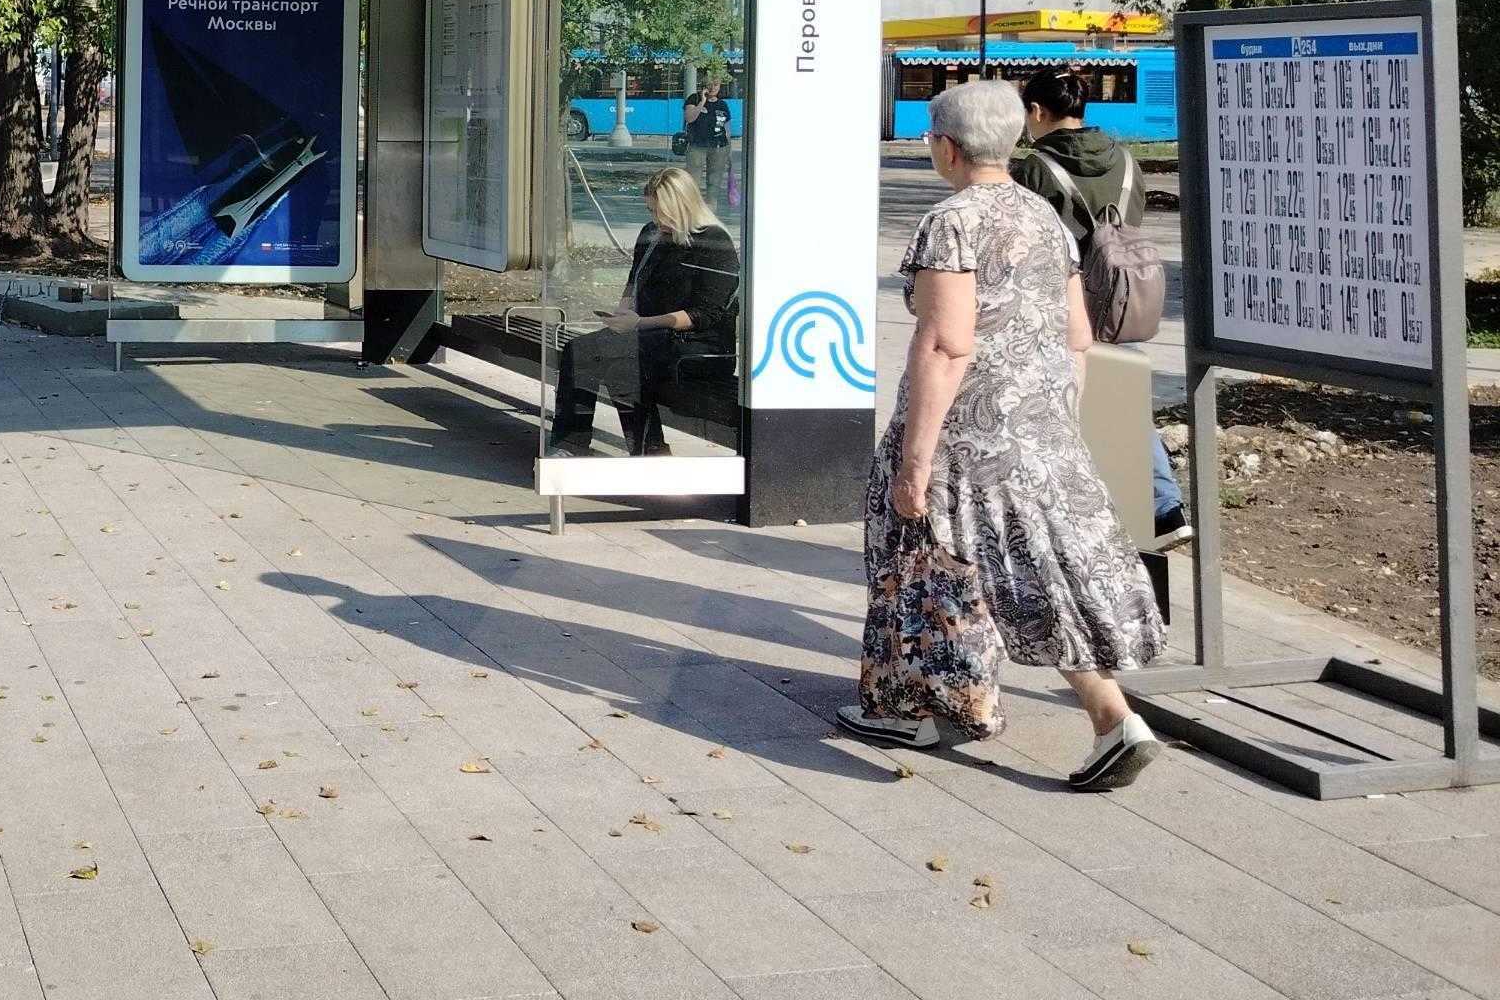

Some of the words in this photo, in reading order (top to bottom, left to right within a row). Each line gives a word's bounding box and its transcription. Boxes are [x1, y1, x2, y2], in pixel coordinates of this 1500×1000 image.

[207, 16, 276, 31] Москвы
[232, 0, 319, 14] транспорт
[1240, 44, 1263, 56] будни
[1301, 39, 1317, 56] 254
[1217, 63, 1222, 108] 5
[1235, 63, 1246, 108] 10
[1259, 62, 1270, 108] 15
[1284, 62, 1295, 108] 20
[1313, 61, 1319, 108] 5
[1334, 60, 1345, 108] 10
[1360, 60, 1372, 109] 15
[1388, 60, 1400, 109] 20
[1219, 116, 1224, 160] 6
[1237, 115, 1246, 161] 11
[1262, 116, 1272, 162] 16
[1286, 116, 1296, 163] 21
[1316, 117, 1321, 164] 6
[1336, 116, 1346, 165] 11
[1363, 117, 1374, 166] 16
[1390, 117, 1401, 168] 21
[1220, 168, 1225, 213] 7
[1239, 168, 1249, 214] 12
[1263, 169, 1272, 216] 17
[1288, 171, 1298, 217] 22
[1317, 172, 1321, 219] 7
[1337, 173, 1349, 221] 12
[1364, 174, 1374, 223] 17
[1392, 175, 1404, 225] 22
[1222, 220, 1227, 264] 8
[1241, 221, 1250, 267] 13
[1265, 223, 1275, 269] 18
[1289, 225, 1300, 272] 23
[1319, 228, 1324, 274] 8
[1339, 229, 1350, 277] 13
[1365, 231, 1376, 280] 18
[1393, 233, 1405, 283] 23
[1224, 272, 1229, 317] 9
[1242, 274, 1252, 320] 14
[1266, 277, 1276, 323] 19
[1296, 280, 1301, 327] 0
[1320, 283, 1325, 330] 9
[1340, 284, 1351, 334] 14
[1367, 288, 1378, 337] 19
[1402, 291, 1408, 341] 0
